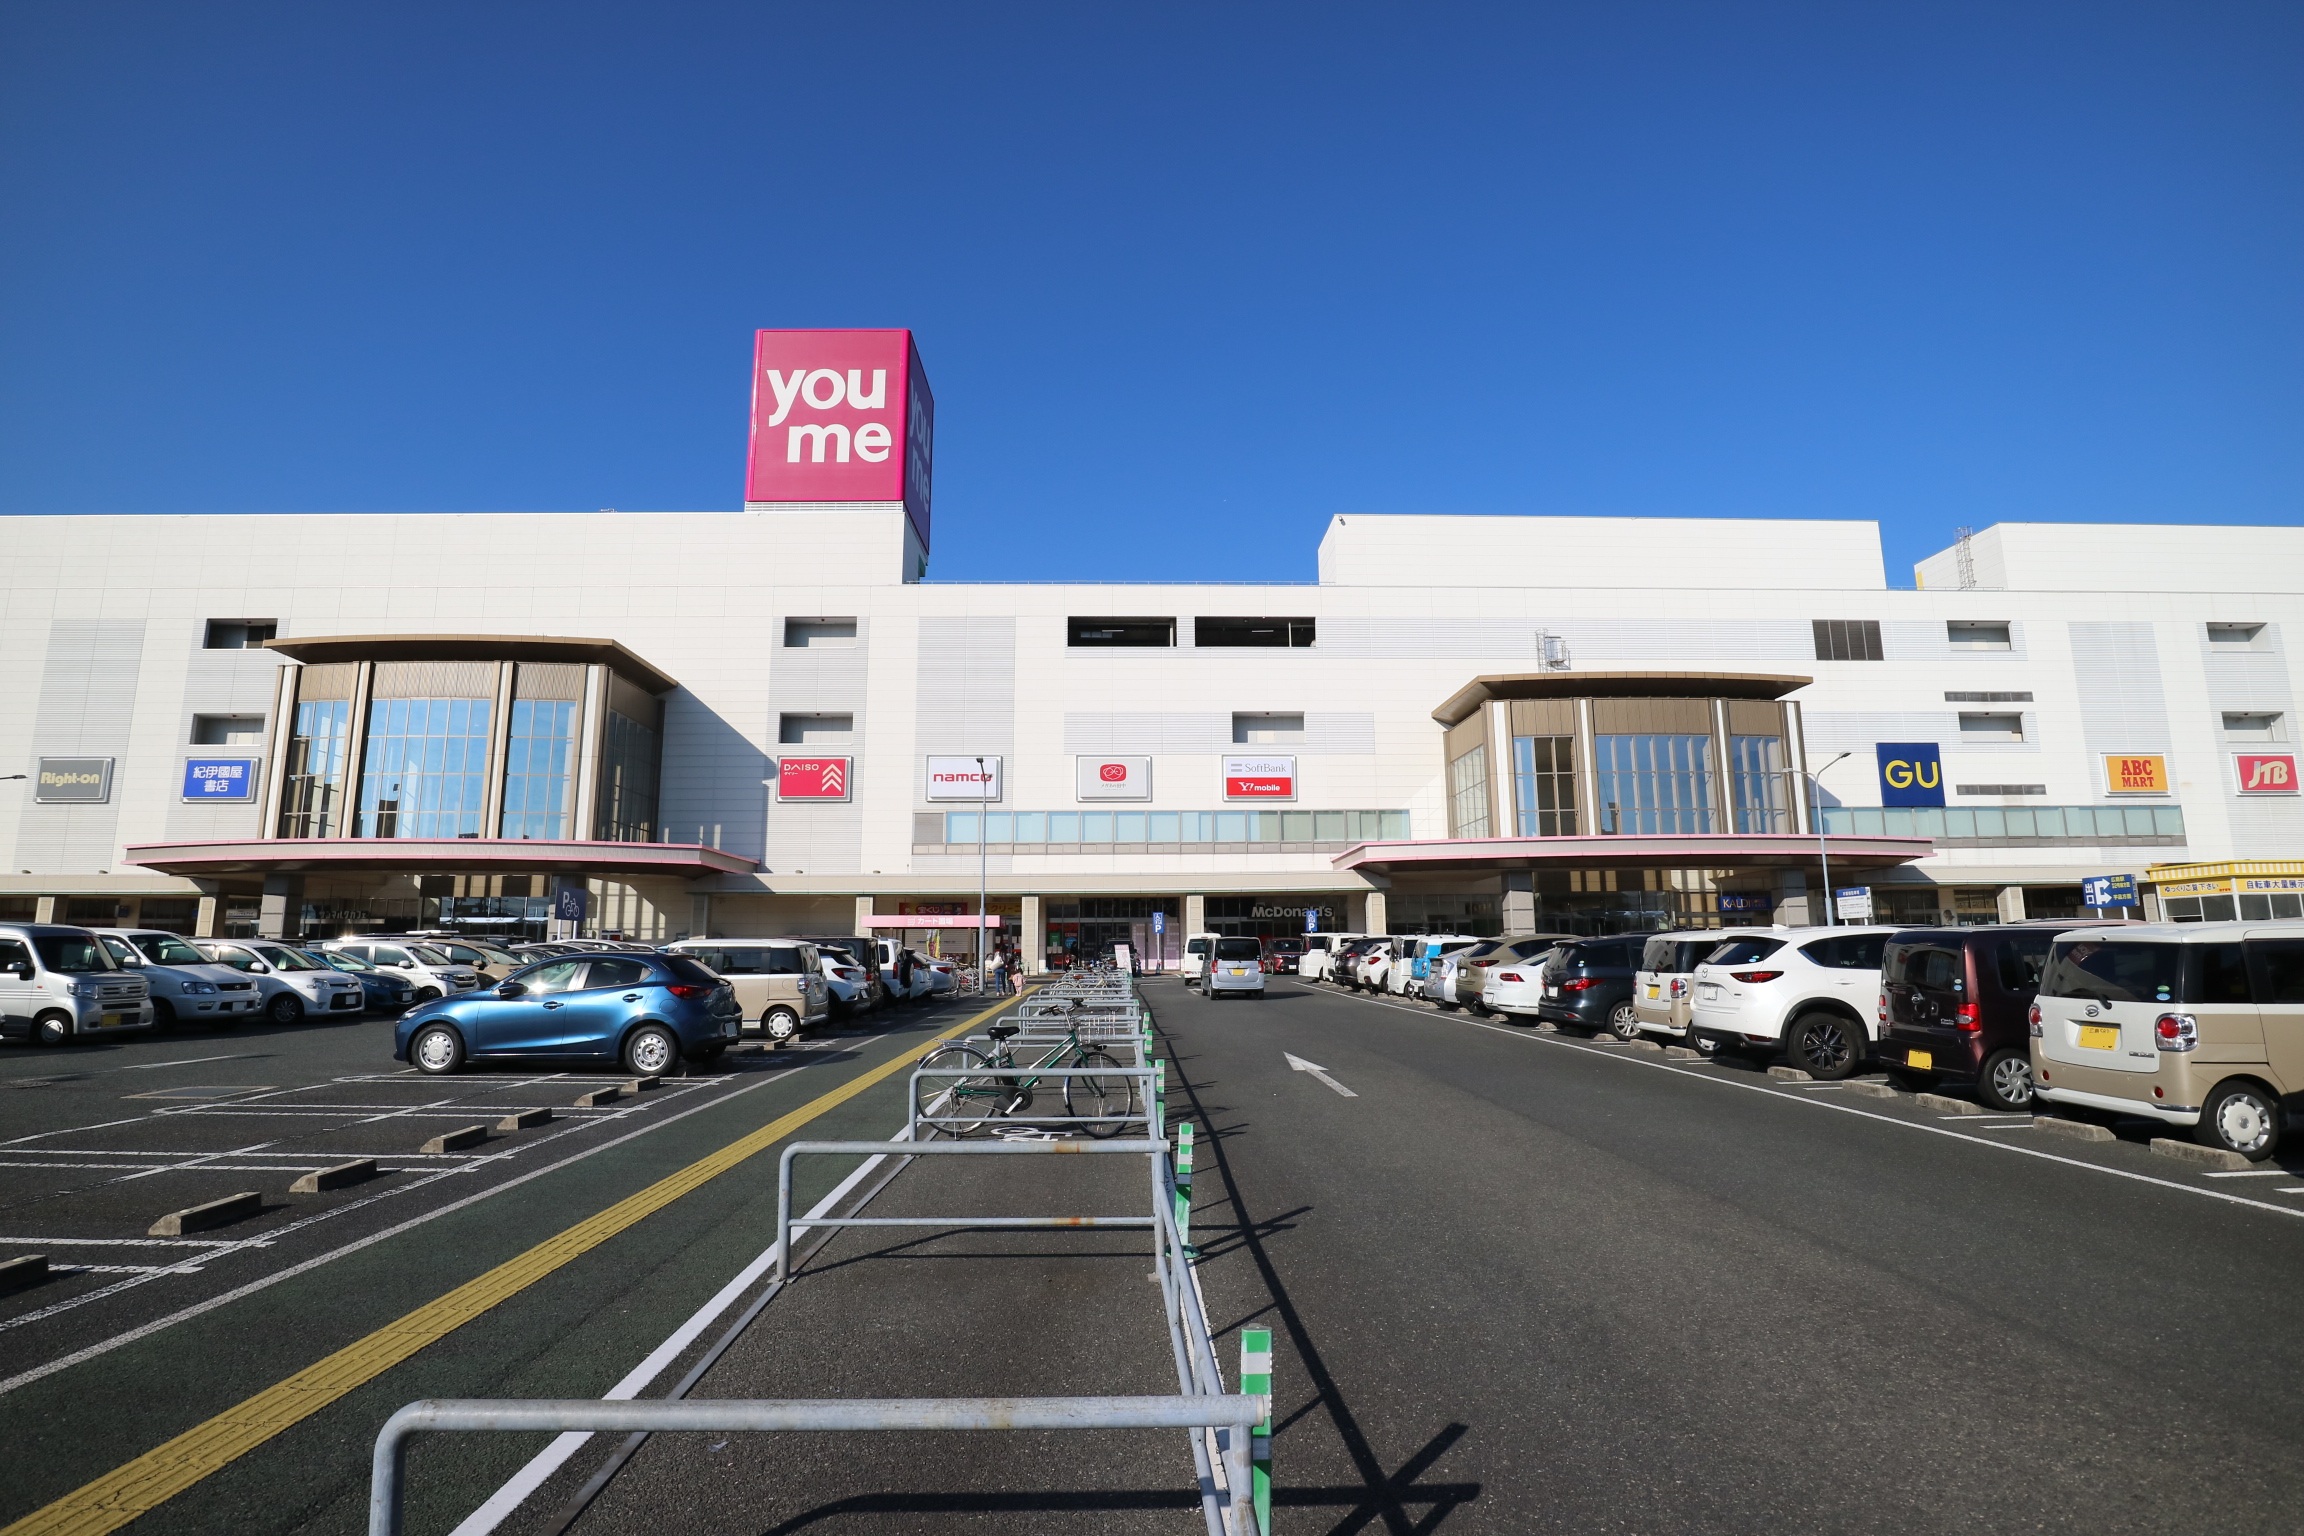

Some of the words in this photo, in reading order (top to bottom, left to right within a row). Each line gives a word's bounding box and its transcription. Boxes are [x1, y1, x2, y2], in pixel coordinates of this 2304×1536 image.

[766, 368, 887, 428] you
[909, 378, 931, 464] you
[786, 422, 892, 463] me
[911, 446, 930, 513] me
[192, 765, 244, 779] 紀伊國屋
[784, 763, 819, 771] DAISO
[1244, 763, 1287, 773] SoftBank
[1884, 759, 1940, 788] GU
[2120, 759, 2153, 775] ABC
[2247, 760, 2289, 789] JTB
[40, 771, 100, 787] Right-on
[203, 779, 230, 792] 書店
[933, 773, 993, 782] namco
[2121, 776, 2155, 788] MART
[2164, 883, 2219, 893] ゆっくりご覧下さい
[2246, 879, 2304, 889] 自転車大量展示
[563, 891, 570, 909] P
[2084, 883, 2095, 905] 出口
[1722, 899, 1751, 908] KALDI
